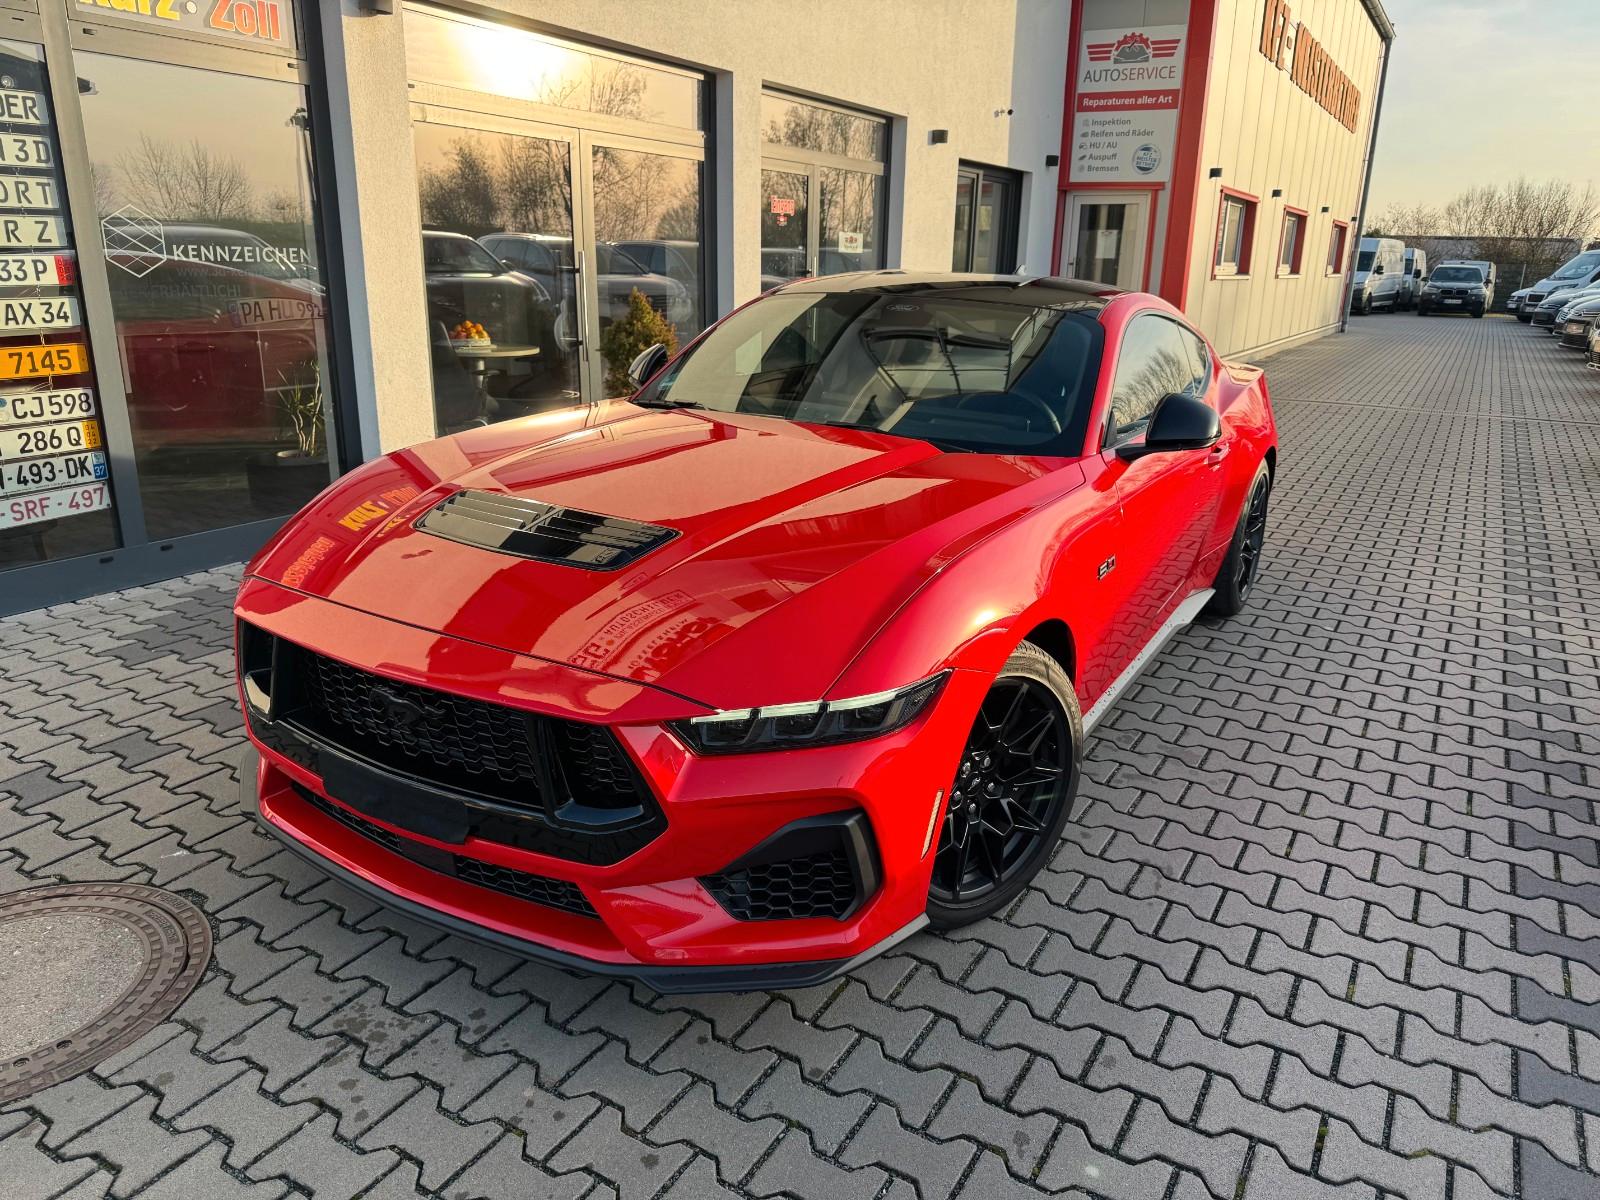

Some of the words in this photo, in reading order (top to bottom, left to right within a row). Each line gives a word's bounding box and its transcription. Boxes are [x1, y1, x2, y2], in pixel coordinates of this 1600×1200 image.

[1083, 65, 1176, 83] AUTOSERVICE
[1083, 97, 1135, 107] Reparaturen
[1137, 96, 1156, 104] aller
[1158, 95, 1172, 104] Art
[1091, 118, 1131, 128] Inspektion
[1090, 130, 1113, 138] Reifen
[1131, 129, 1154, 137] Räder
[1088, 153, 1117, 162] Auspuff
[172, 244, 311, 263] KENNZEICHEN
[8, 349, 72, 374] 7145
[0, 456, 92, 490] -493-DK
[94, 464, 105, 476] 37
